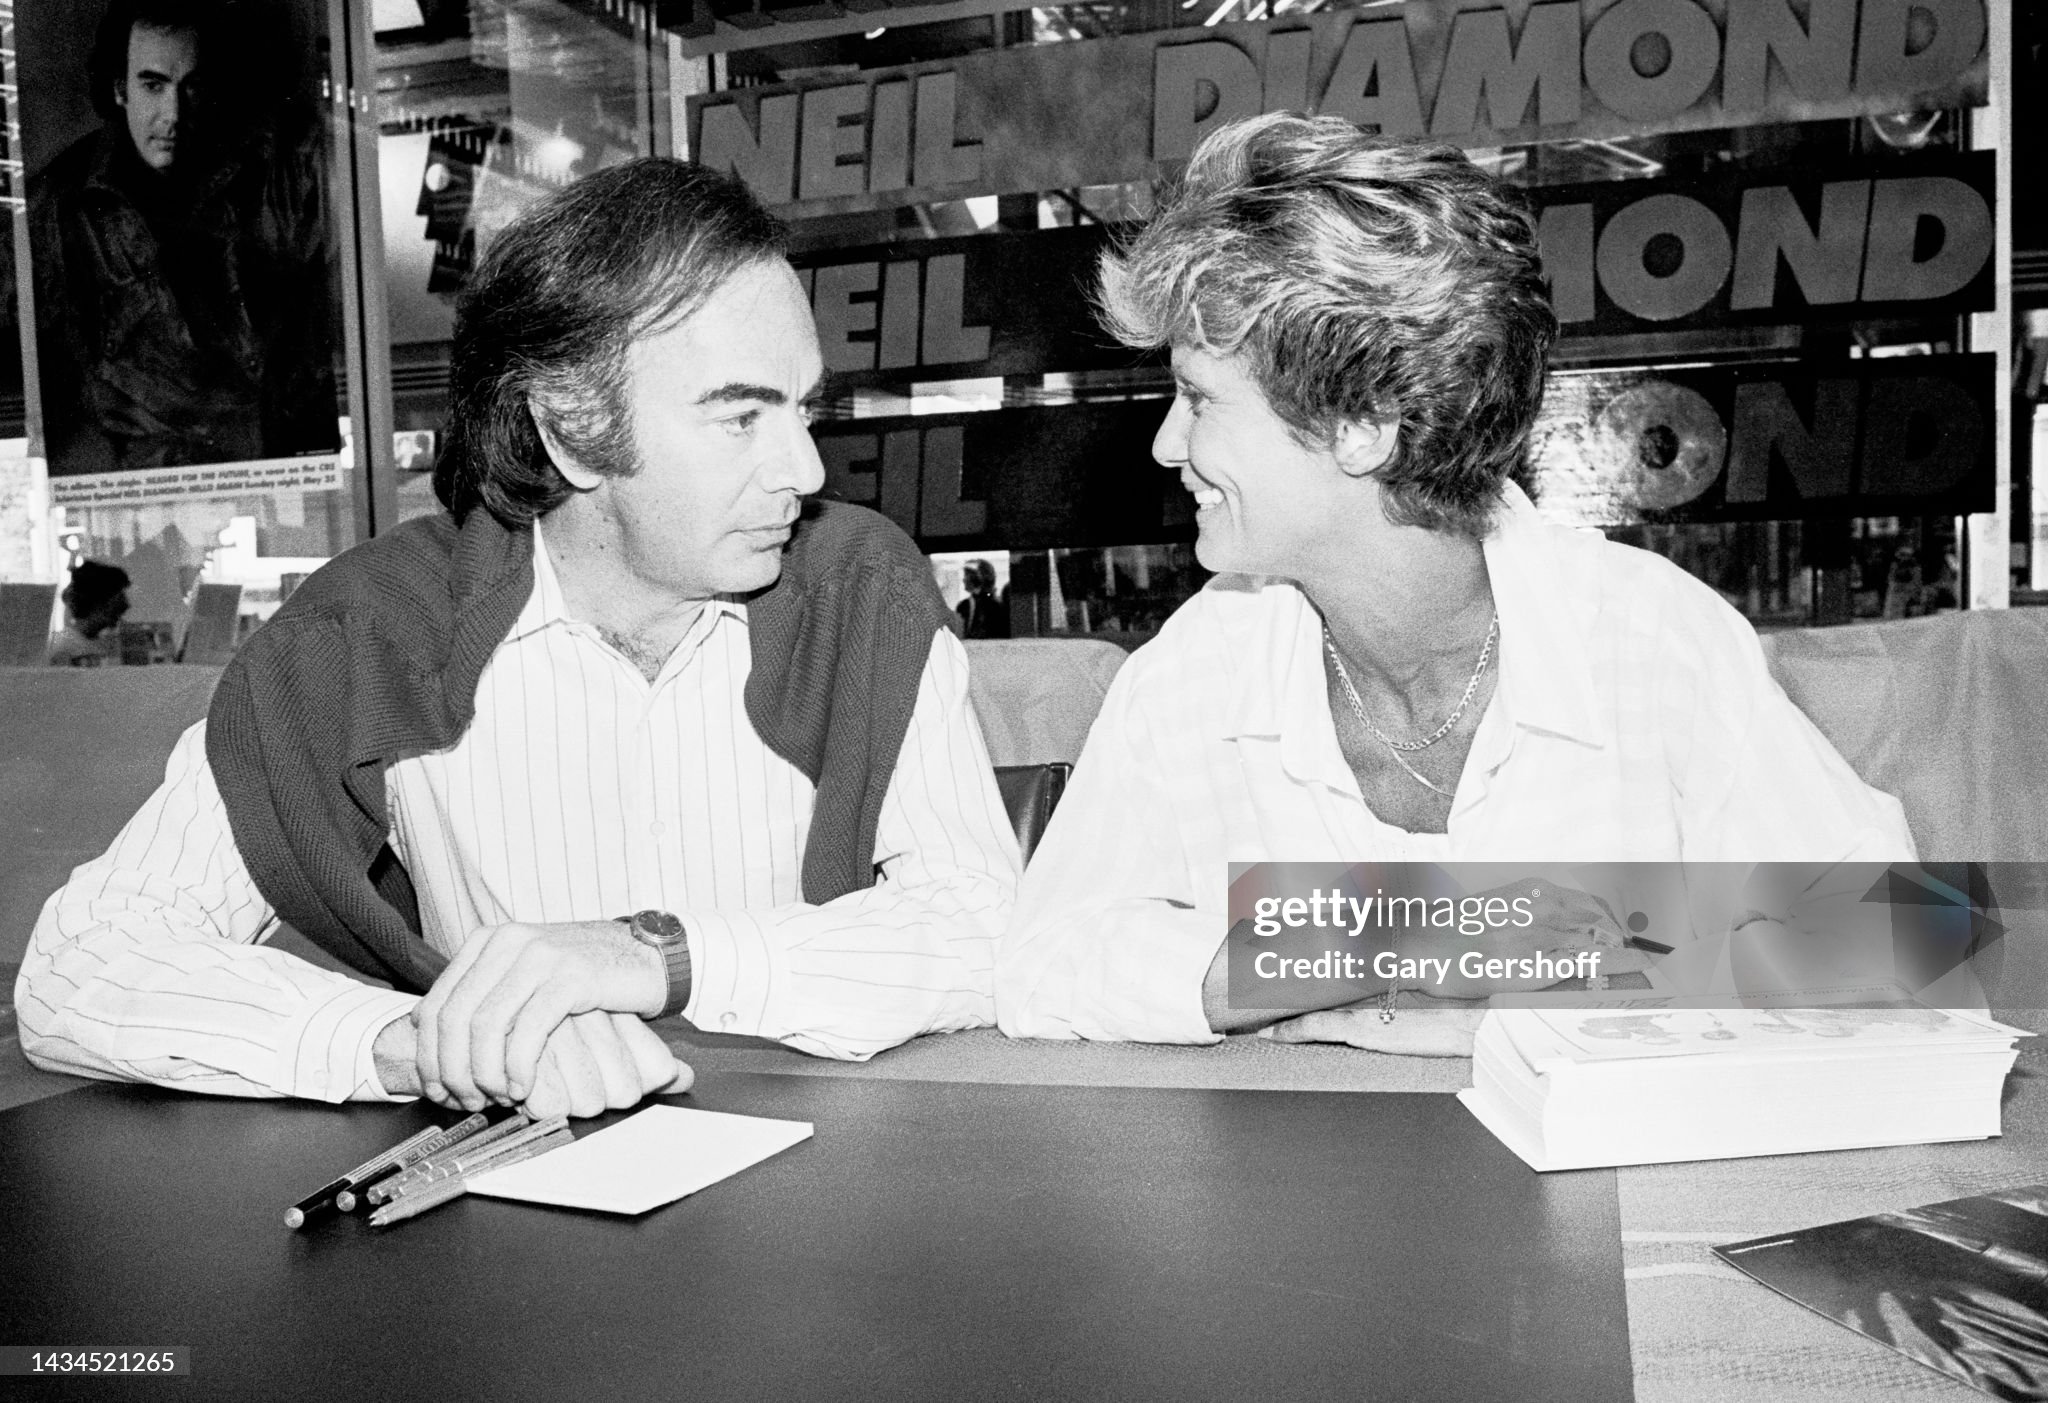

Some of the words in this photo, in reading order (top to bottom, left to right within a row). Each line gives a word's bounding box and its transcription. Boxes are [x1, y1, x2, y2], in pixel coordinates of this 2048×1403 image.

[700, 71, 983, 203] NEIL
[1152, 0, 1988, 161] DIAMOND
[801, 254, 991, 373] EIL
